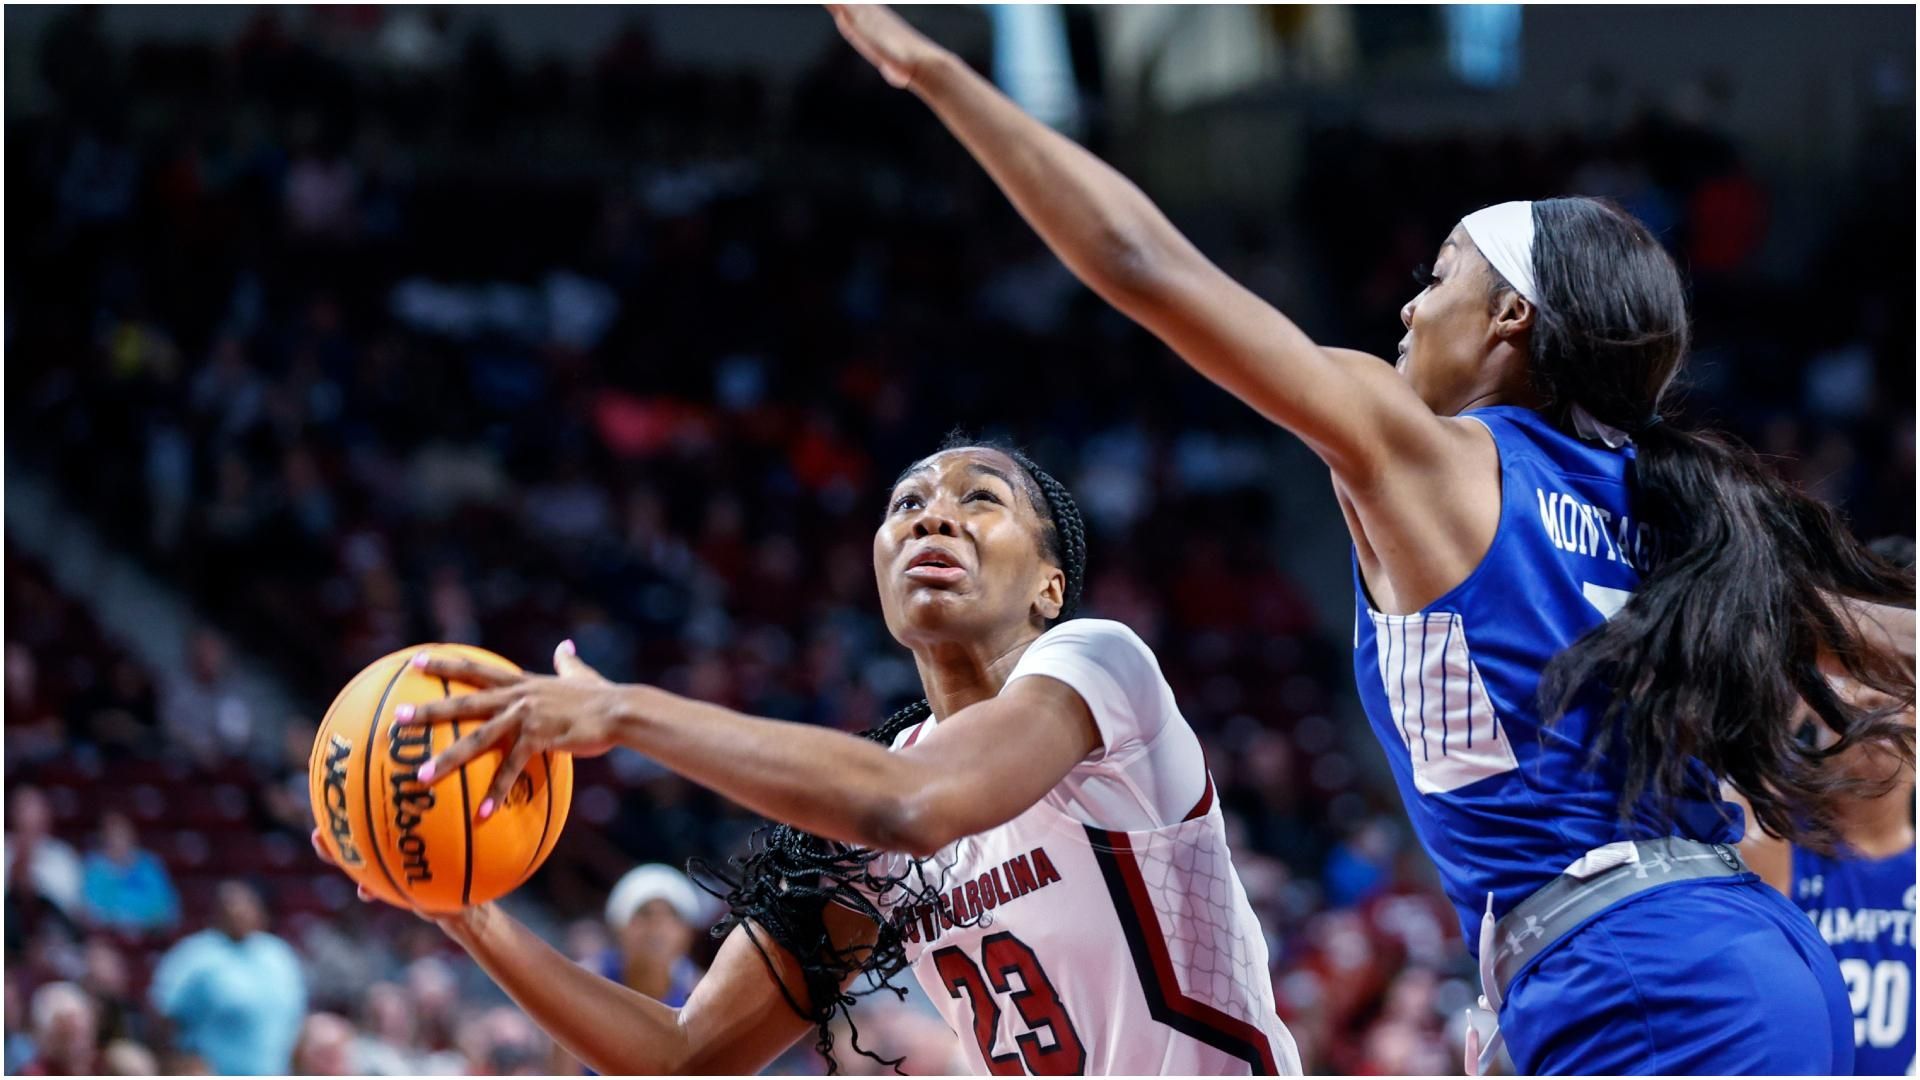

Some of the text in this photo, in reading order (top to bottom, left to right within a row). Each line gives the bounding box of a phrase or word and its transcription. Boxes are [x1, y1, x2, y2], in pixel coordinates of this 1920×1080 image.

[1537, 488, 1650, 572] MONTAG
[323, 731, 367, 868] NCAA
[388, 719, 436, 887] Wilson
[937, 846, 1062, 931] CAROLINA
[1807, 907, 1916, 949] AMPT
[932, 931, 1087, 1076] 23
[1839, 958, 1911, 1049] 20
